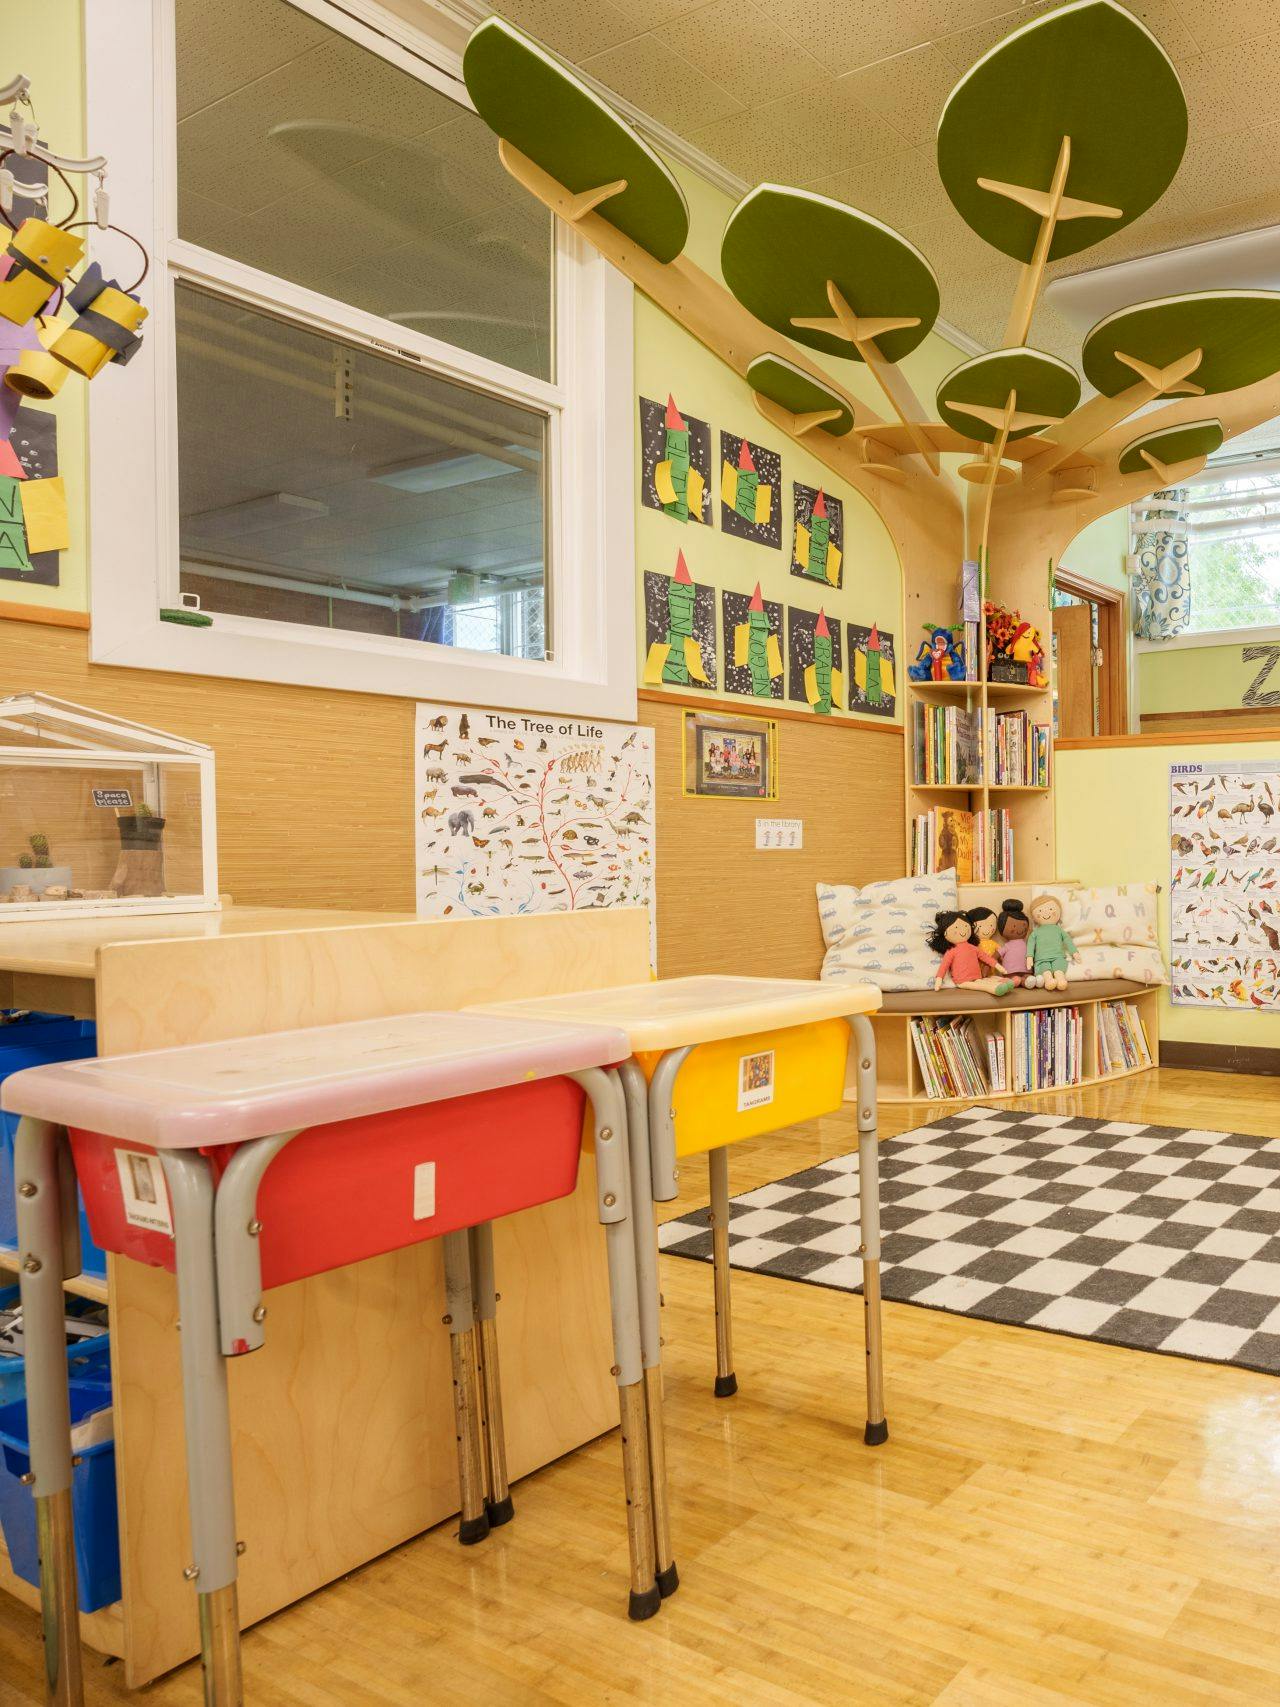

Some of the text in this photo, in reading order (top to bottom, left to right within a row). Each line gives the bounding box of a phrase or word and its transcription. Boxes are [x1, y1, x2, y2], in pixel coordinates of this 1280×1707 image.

[738, 473, 756, 520] ADA
[811, 520, 829, 576] LUCA
[1242, 646, 1280, 707] Z
[486, 714, 516, 731] The
[521, 718, 554, 734] Tree
[558, 723, 573, 736] of
[577, 724, 604, 740] Life
[1171, 765, 1203, 774] BIRDS
[96, 790, 127, 800] Space
[961, 813, 971, 821] Me
[1105, 904, 1116, 918] Q
[1128, 951, 1136, 961] F
